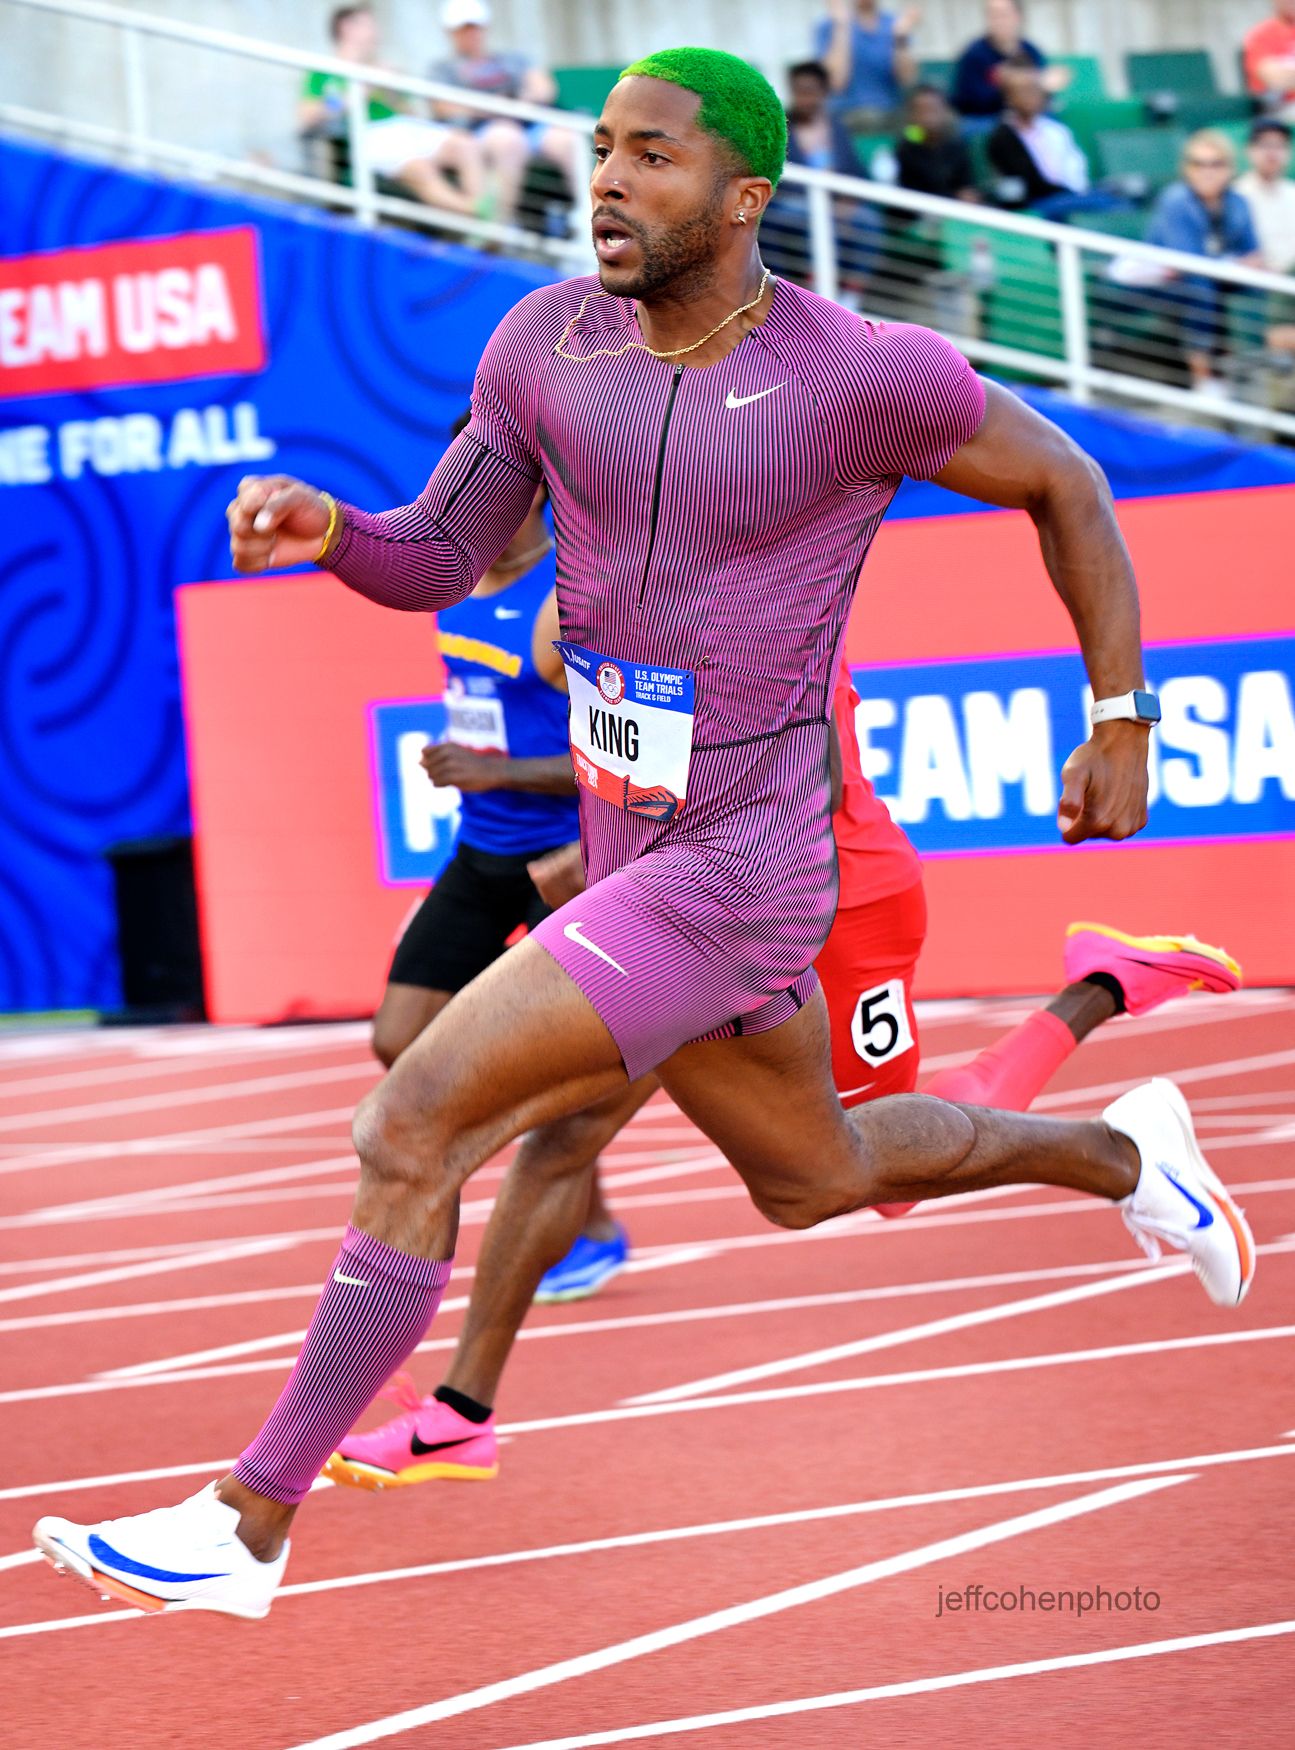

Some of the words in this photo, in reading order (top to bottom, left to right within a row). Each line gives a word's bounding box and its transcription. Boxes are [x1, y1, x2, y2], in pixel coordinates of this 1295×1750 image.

[112, 264, 237, 353] USA
[59, 413, 162, 478] FOR
[168, 402, 275, 468] ALL
[634, 669, 649, 681] U.S.
[651, 671, 683, 685] OLYMPIC
[635, 680, 655, 693] TEAM
[656, 683, 683, 696] TRIALS
[635, 691, 651, 701] TRACK
[657, 694, 671, 703] FIELD
[589, 705, 639, 762] KING
[1082, 670, 1295, 808] SA
[861, 989, 899, 1057] 5
